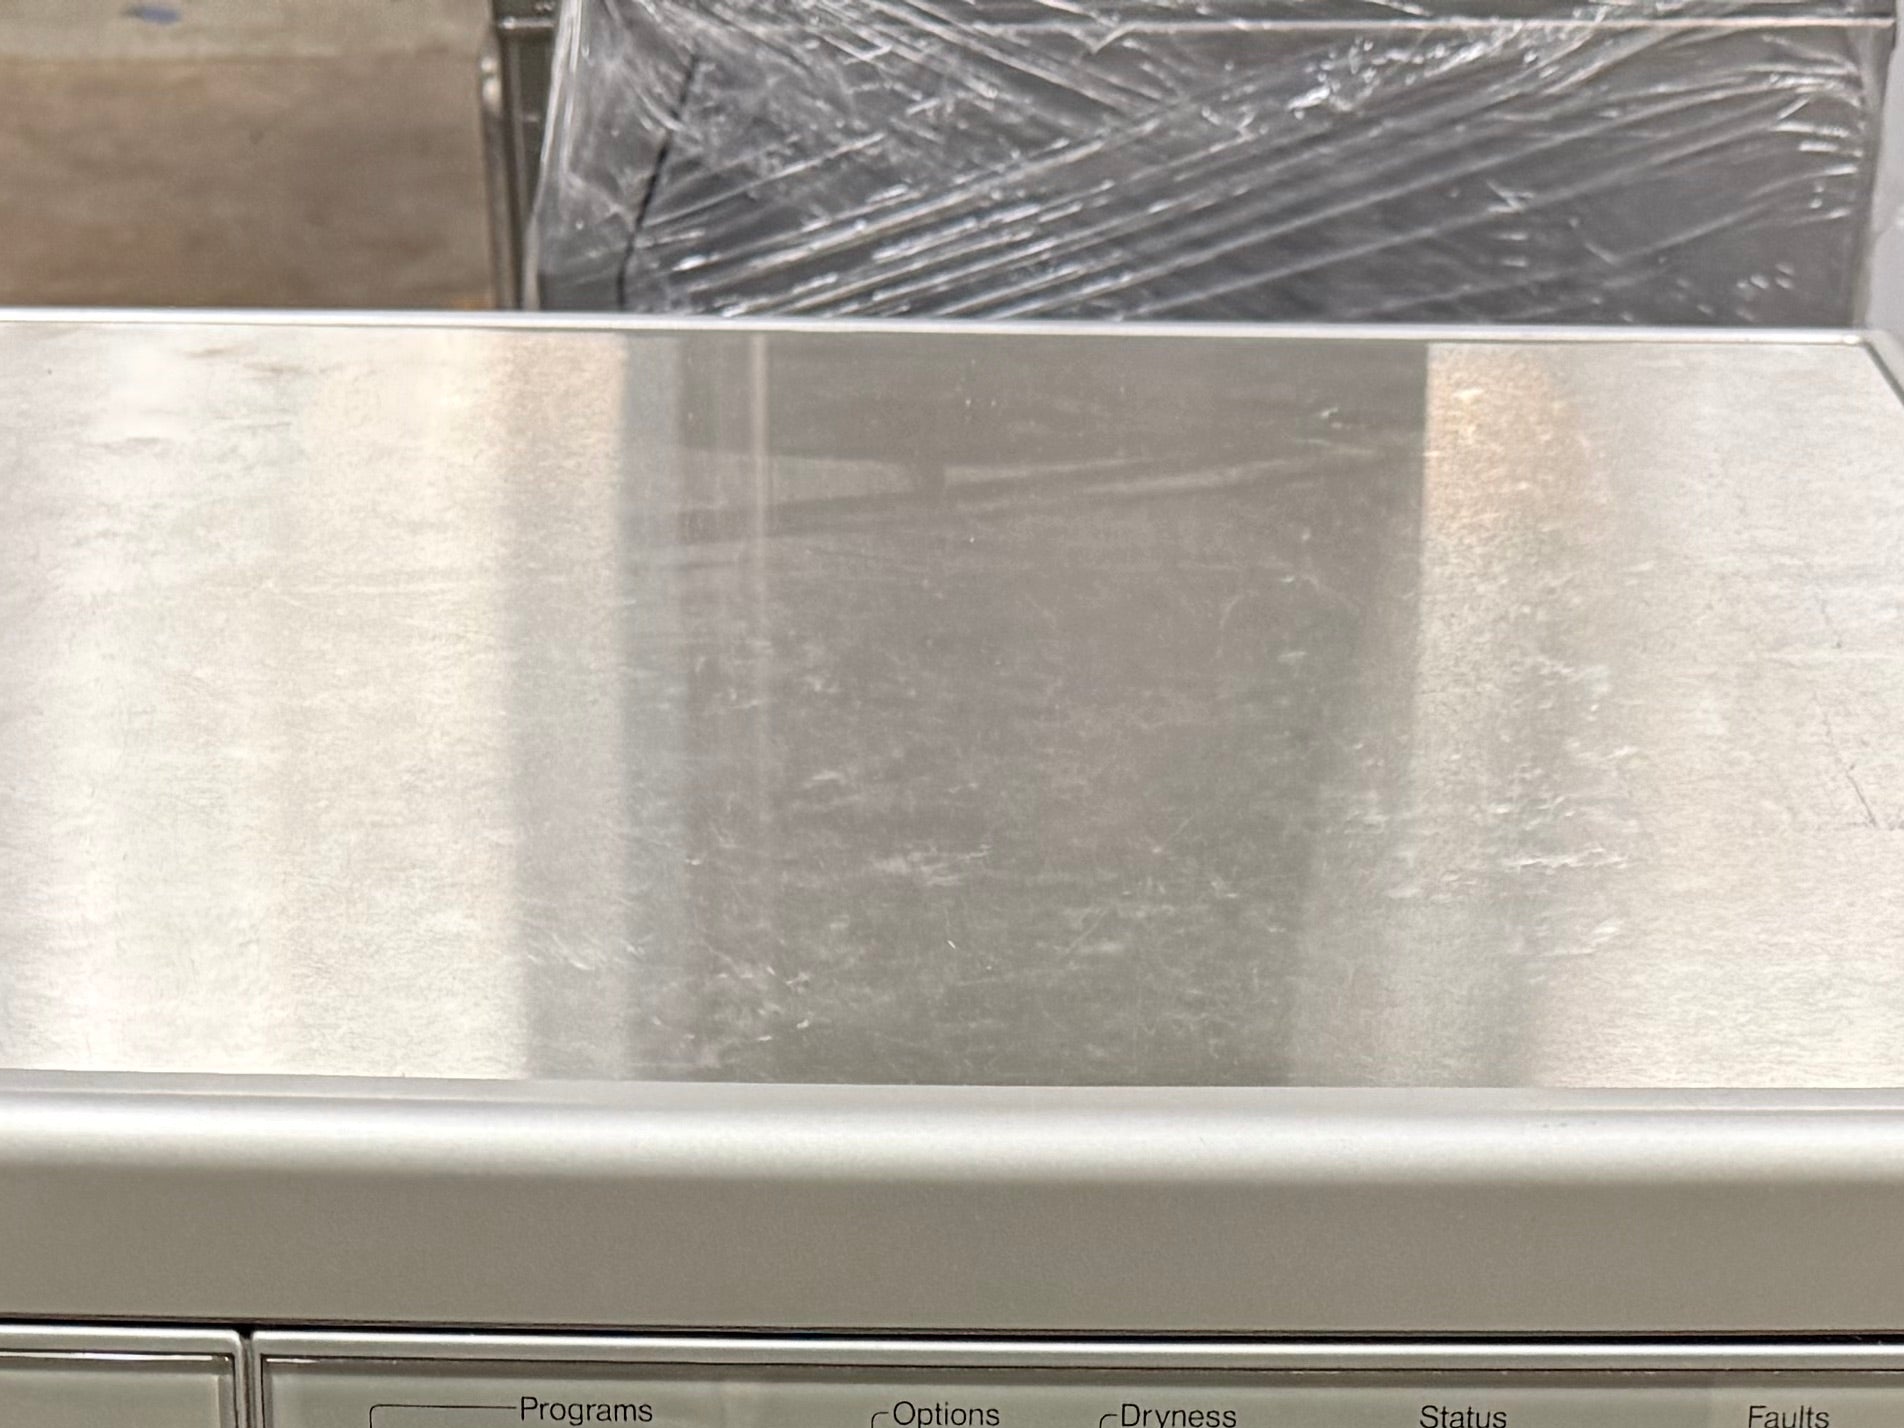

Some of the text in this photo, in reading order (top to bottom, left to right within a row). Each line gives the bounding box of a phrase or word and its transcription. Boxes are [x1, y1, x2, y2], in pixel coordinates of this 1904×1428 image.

[521, 1396, 652, 1426] Programs
[1420, 1405, 1506, 1428] Status
[1749, 1406, 1829, 1428] Faults
